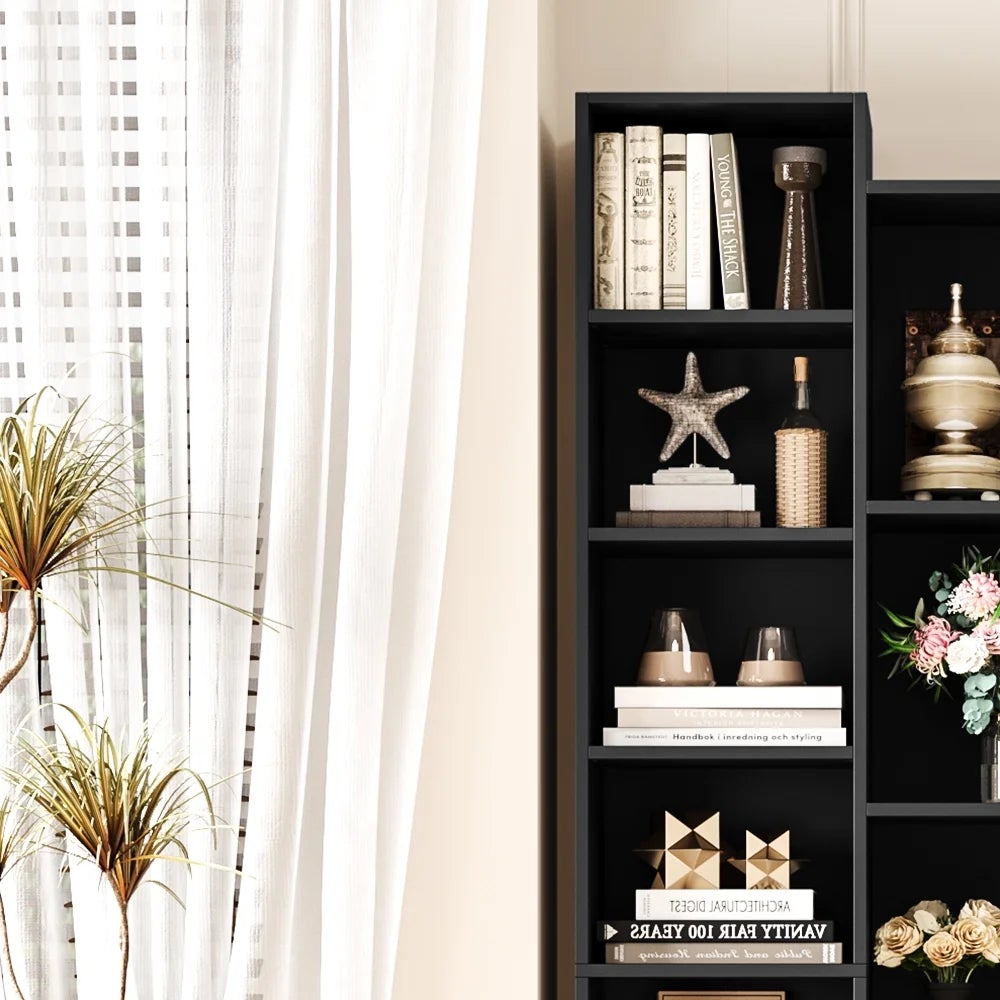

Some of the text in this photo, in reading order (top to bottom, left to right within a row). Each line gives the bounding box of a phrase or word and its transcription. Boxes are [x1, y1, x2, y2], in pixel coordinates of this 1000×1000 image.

[716, 153, 731, 199] YOUNG
[719, 211, 739, 278] THE SHACK
[673, 710, 803, 719] VICTORIA HAGAN
[672, 733, 714, 741] Handbok
[723, 733, 769, 742] inredning
[771, 733, 788, 741] och
[791, 733, 823, 742] styling
